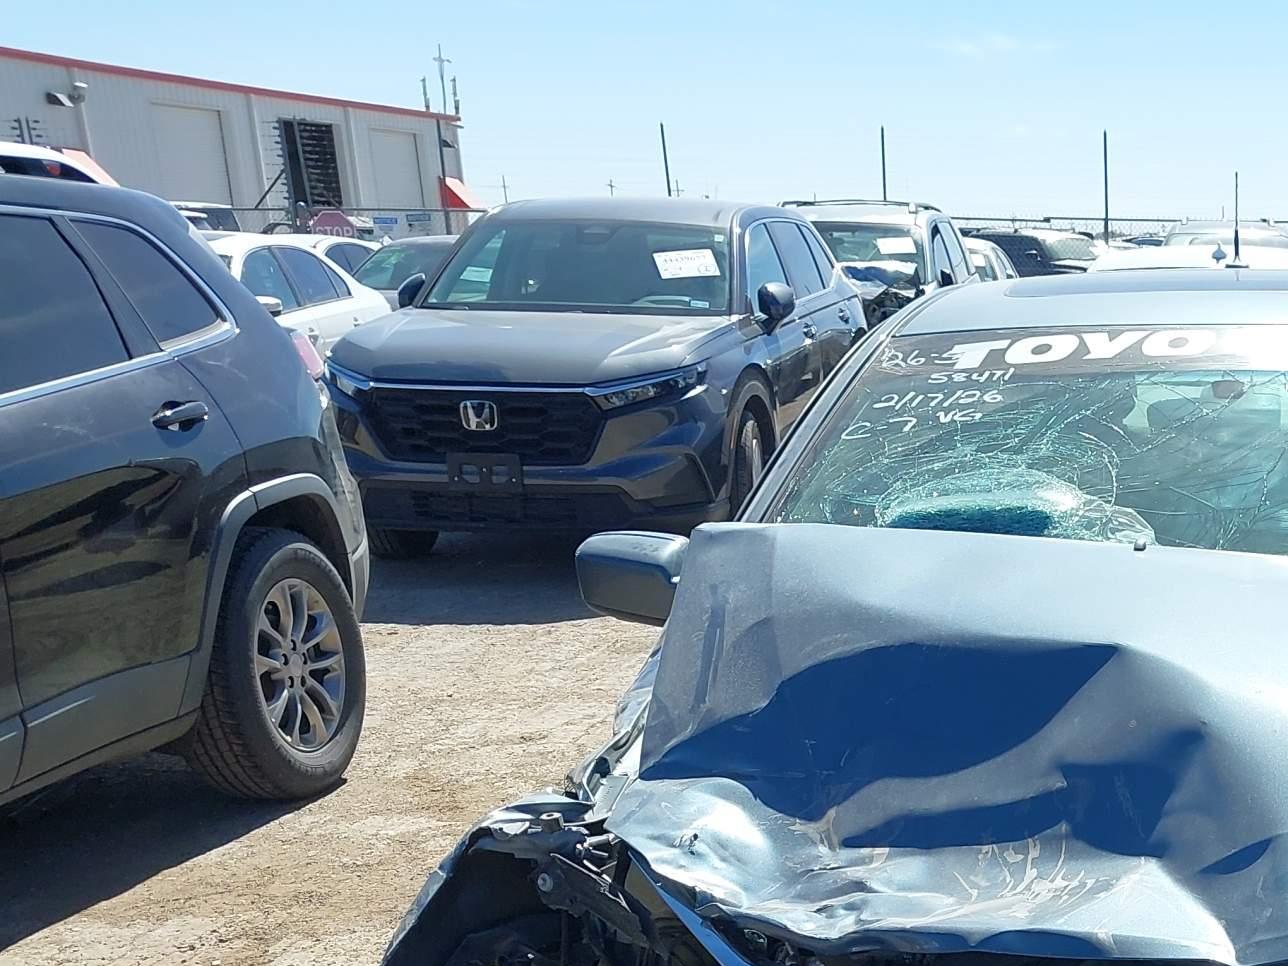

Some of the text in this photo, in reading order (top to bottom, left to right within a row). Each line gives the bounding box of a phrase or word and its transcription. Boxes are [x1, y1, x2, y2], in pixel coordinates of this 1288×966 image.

[315, 226, 353, 238] STOP
[953, 329, 1218, 369] TOYO
[928, 367, 1015, 383] 58471
[873, 389, 1004, 409] 2/17/26
